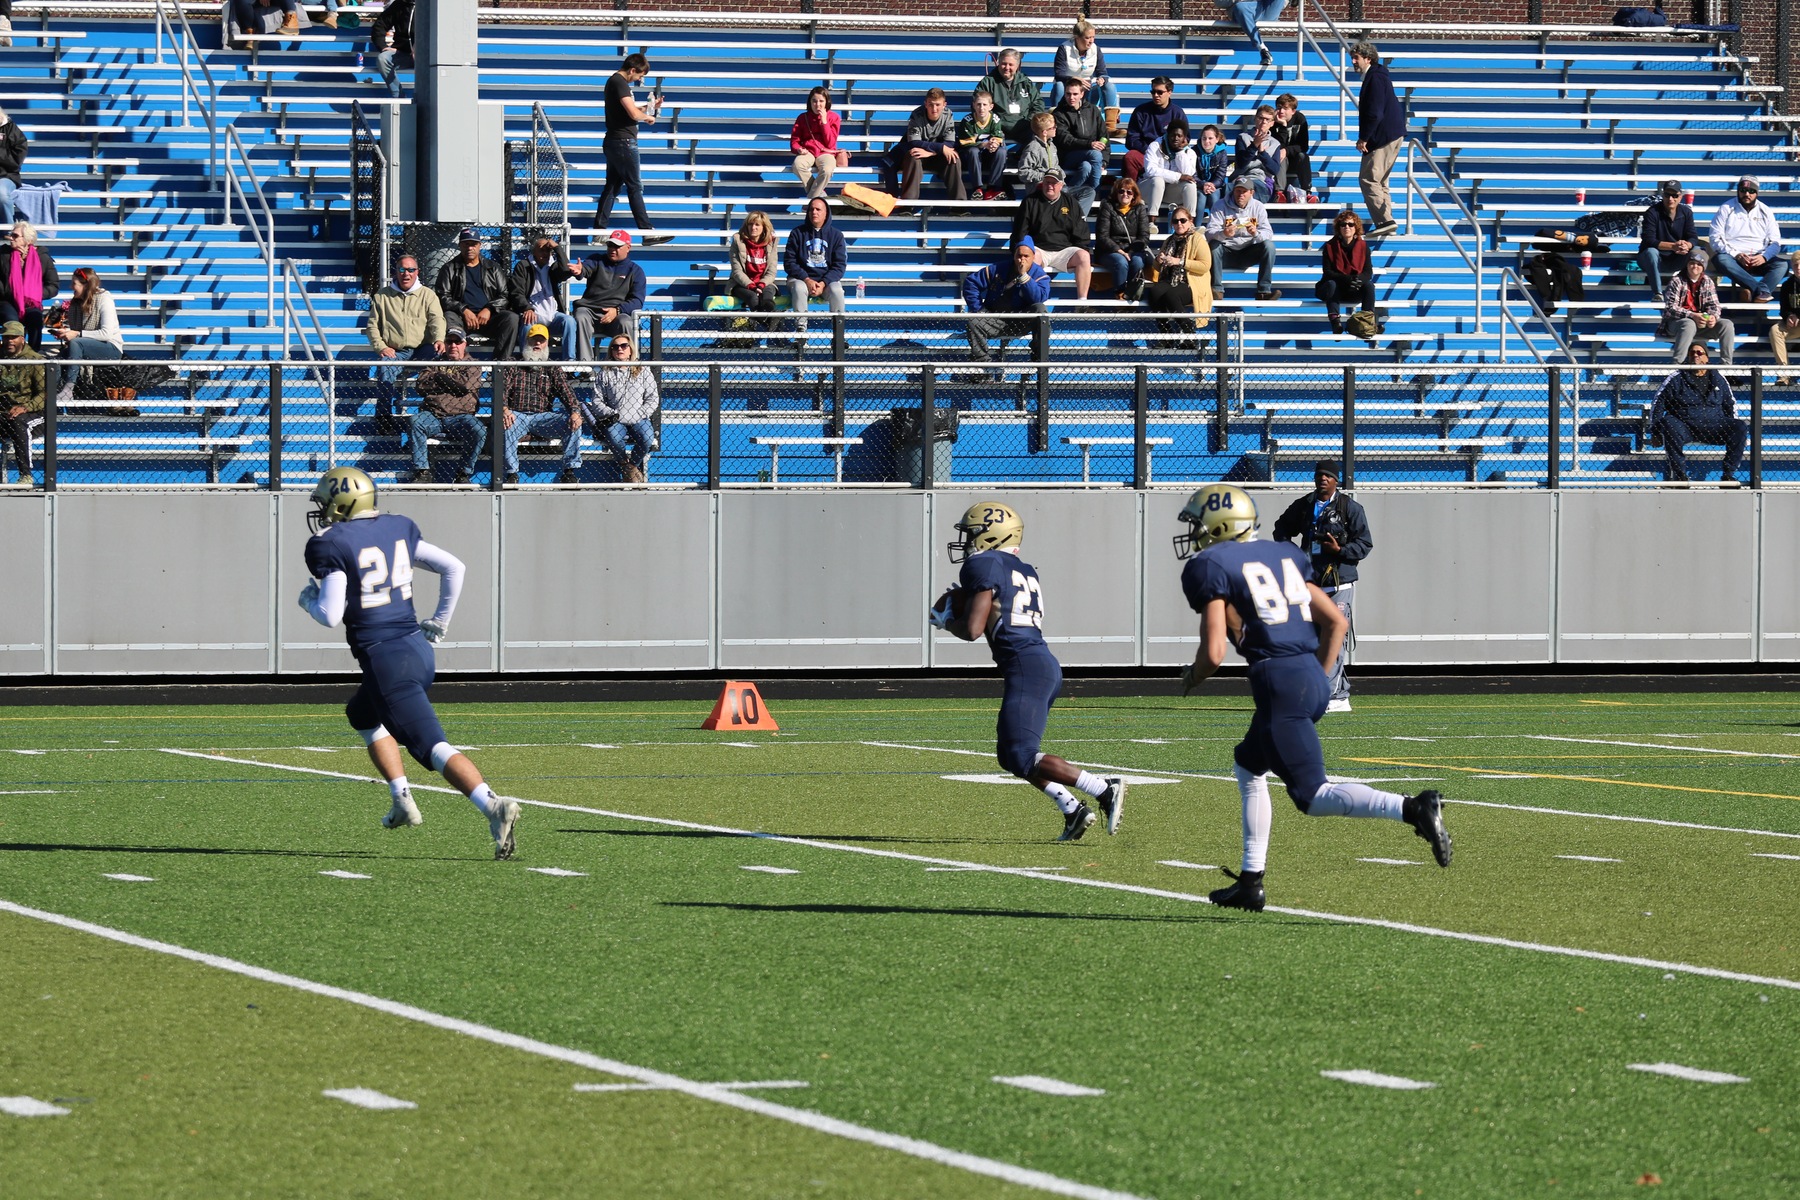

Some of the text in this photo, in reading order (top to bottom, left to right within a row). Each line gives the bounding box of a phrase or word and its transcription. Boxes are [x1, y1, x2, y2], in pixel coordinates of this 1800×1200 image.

[329, 477, 350, 495] 24
[983, 508, 1005, 524] 23
[1208, 492, 1233, 512] 84
[358, 539, 414, 609] 24
[1242, 557, 1313, 625] 84
[728, 688, 760, 725] 10
